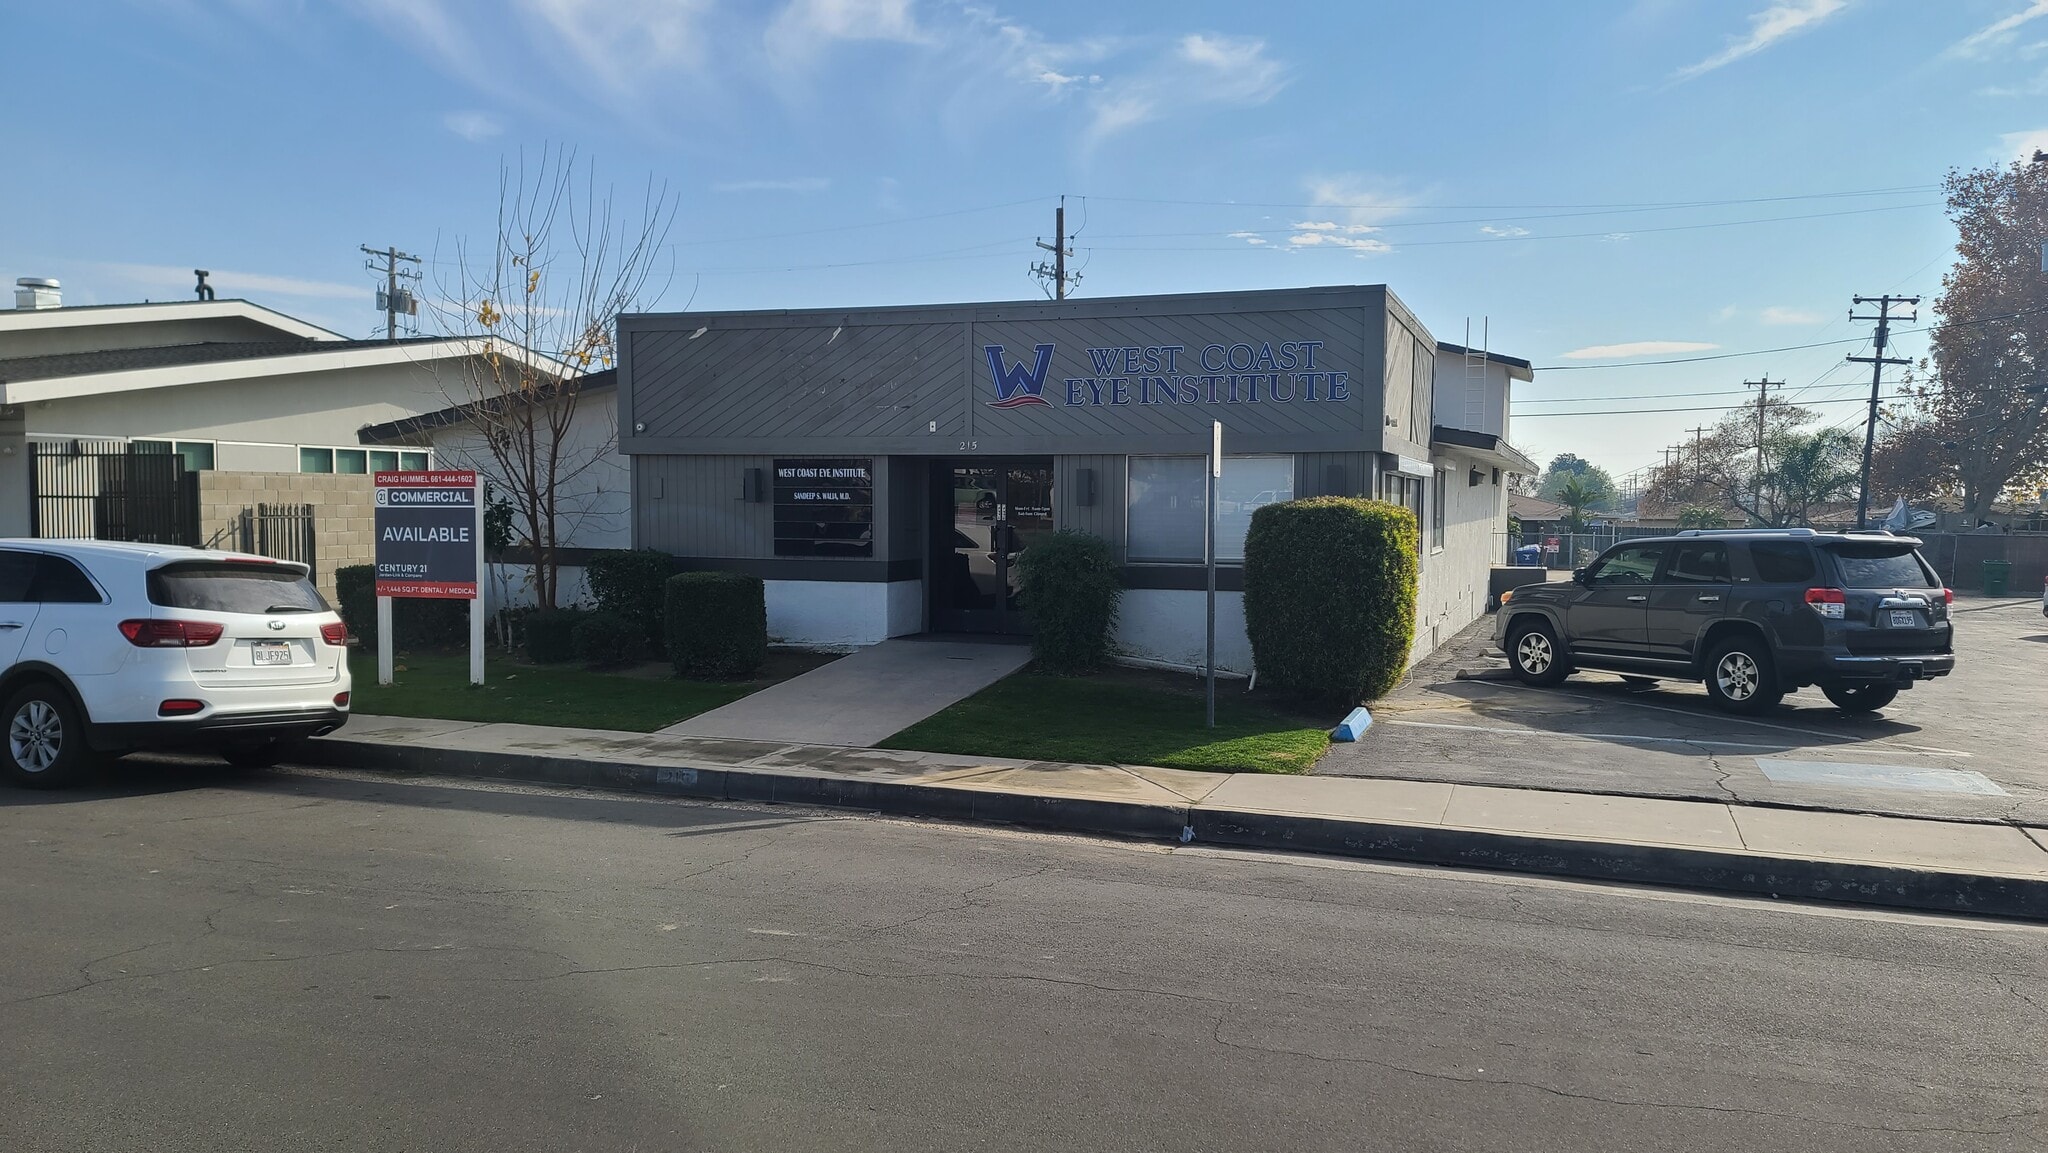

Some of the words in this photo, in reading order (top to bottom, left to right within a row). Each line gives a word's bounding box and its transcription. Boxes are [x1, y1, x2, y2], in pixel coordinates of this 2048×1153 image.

[1085, 345, 1184, 376] WEST
[1200, 340, 1325, 373] COAST
[1063, 376, 1131, 407] EYE
[1138, 371, 1351, 406] INSTITUTE
[960, 441, 977, 450] 215
[778, 468, 796, 478] WEST
[796, 468, 817, 478] COAST
[819, 468, 831, 478] EYE
[832, 468, 866, 478] INSTITUTE
[377, 475, 399, 483] CRAIG
[400, 475, 430, 483] HUMMEL
[430, 475, 473, 483] 661-444-1602
[391, 491, 469, 503] COMMERCIAL
[793, 492, 815, 500] SANDEEP
[816, 492, 822, 500] S.
[839, 492, 851, 500] M.D.
[383, 527, 469, 542] AVAILABLE
[379, 564, 418, 573] CENTURY
[419, 565, 427, 573] 21
[420, 586, 443, 594] DENTAL
[448, 587, 476, 595] MEDICAL
